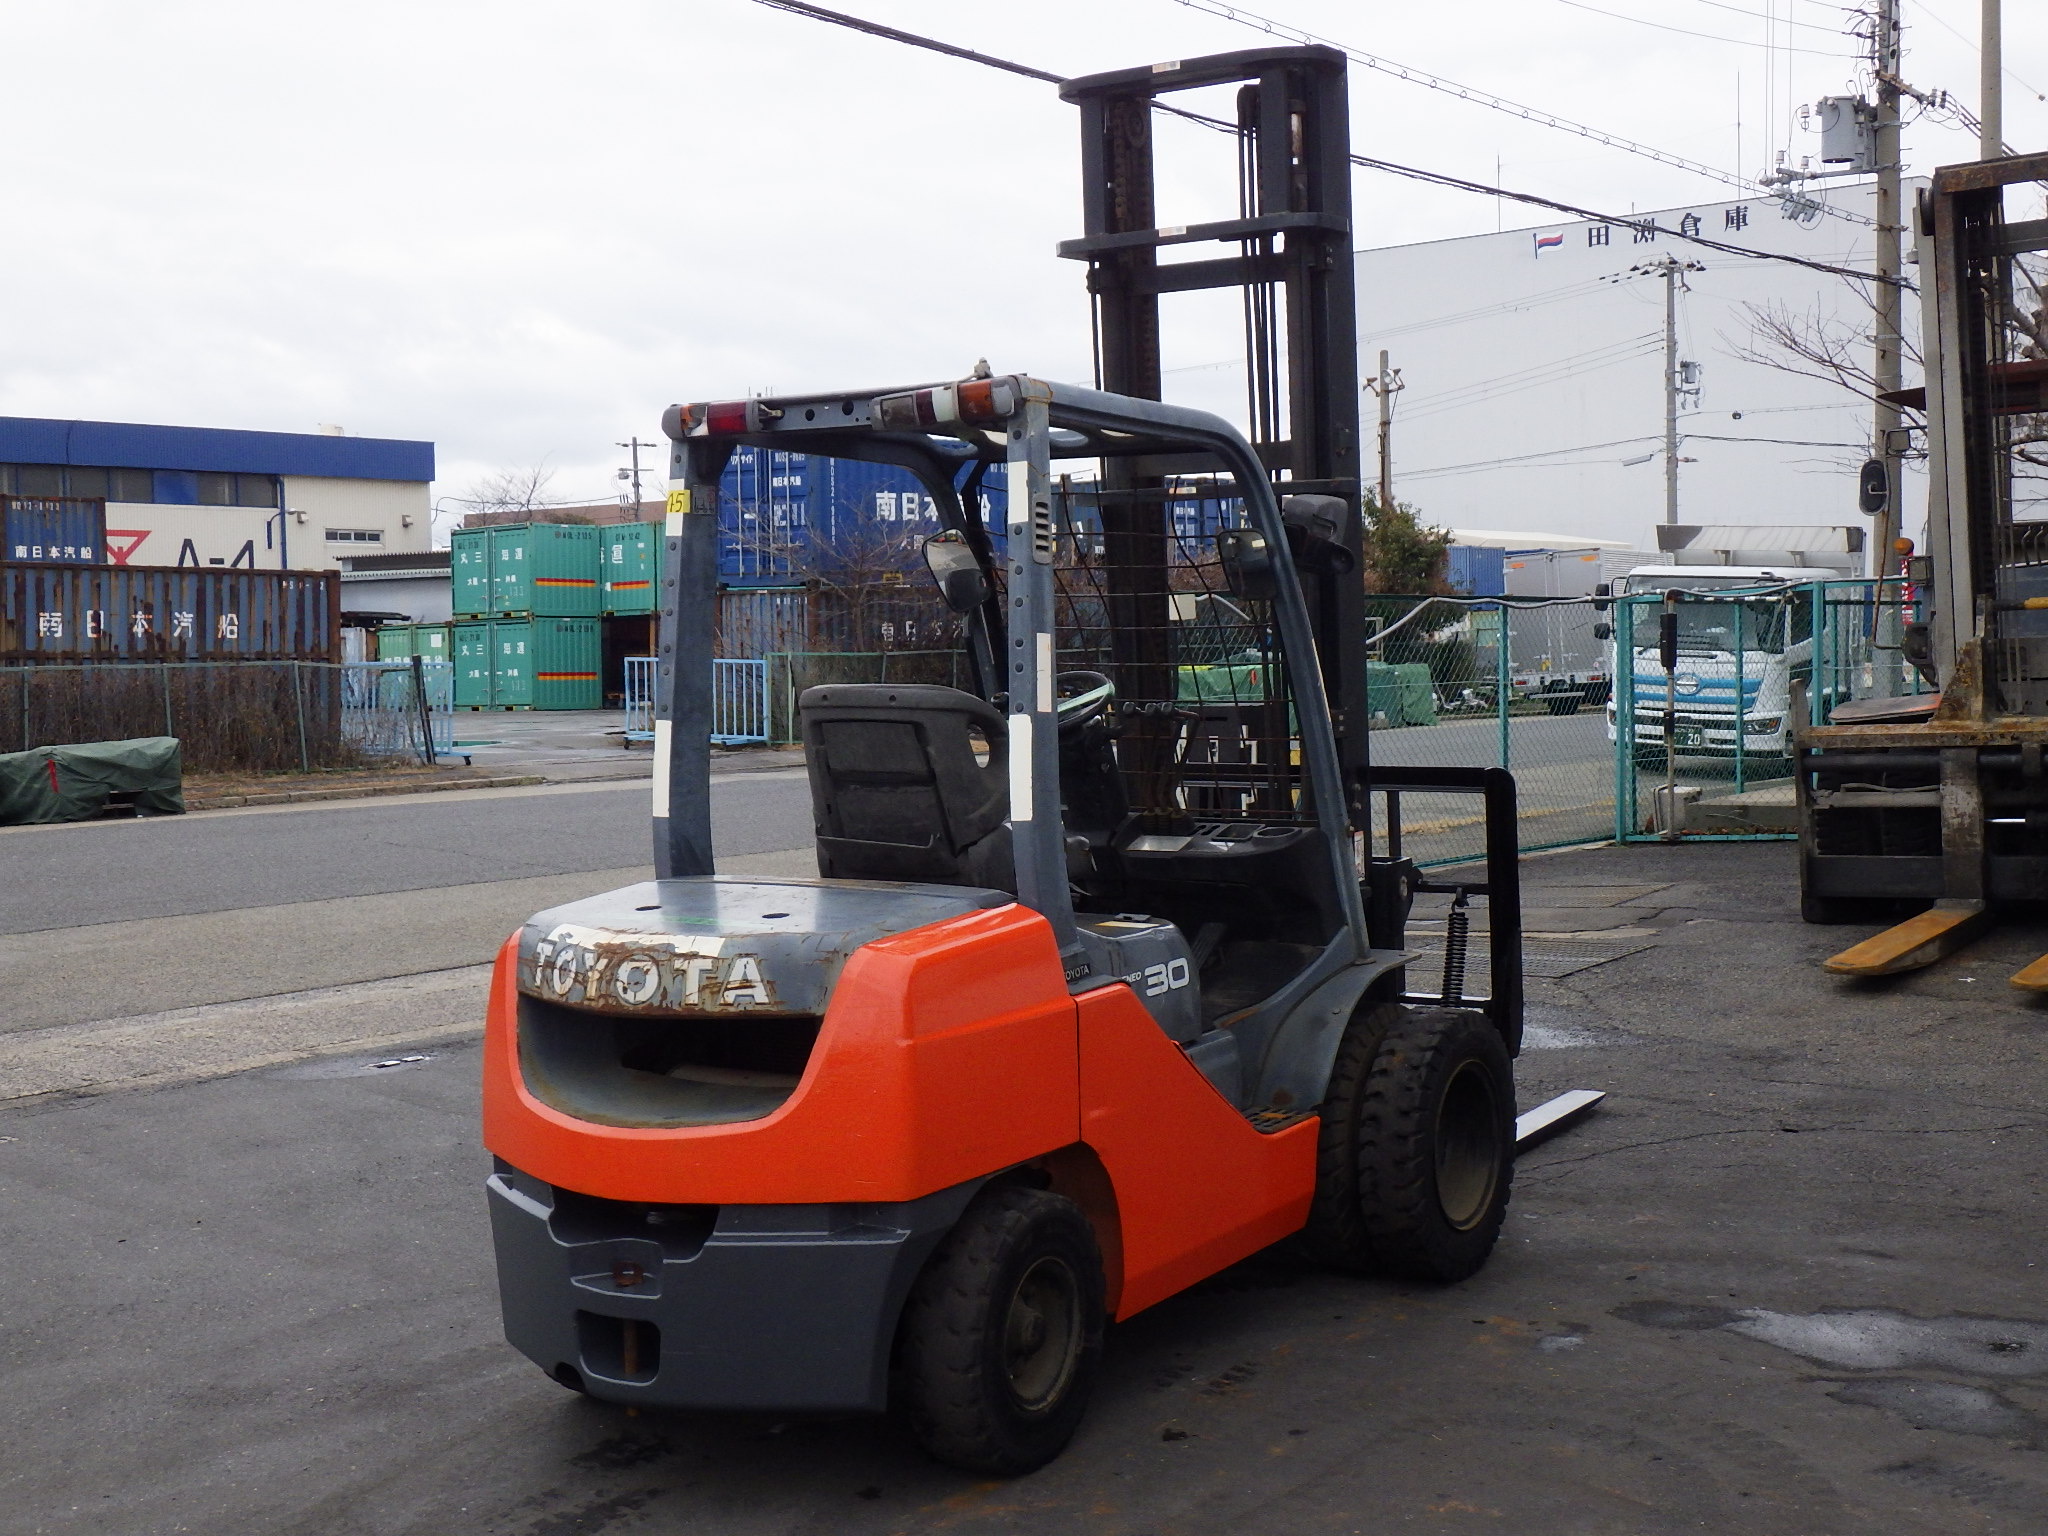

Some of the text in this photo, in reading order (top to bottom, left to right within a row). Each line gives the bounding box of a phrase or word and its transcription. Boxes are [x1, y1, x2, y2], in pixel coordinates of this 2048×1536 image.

[15, 544, 92, 559] 南日本汽船
[533, 938, 773, 1007] TOYOTA
[1063, 963, 1090, 981] OYOTA
[1144, 957, 1190, 997] 30
